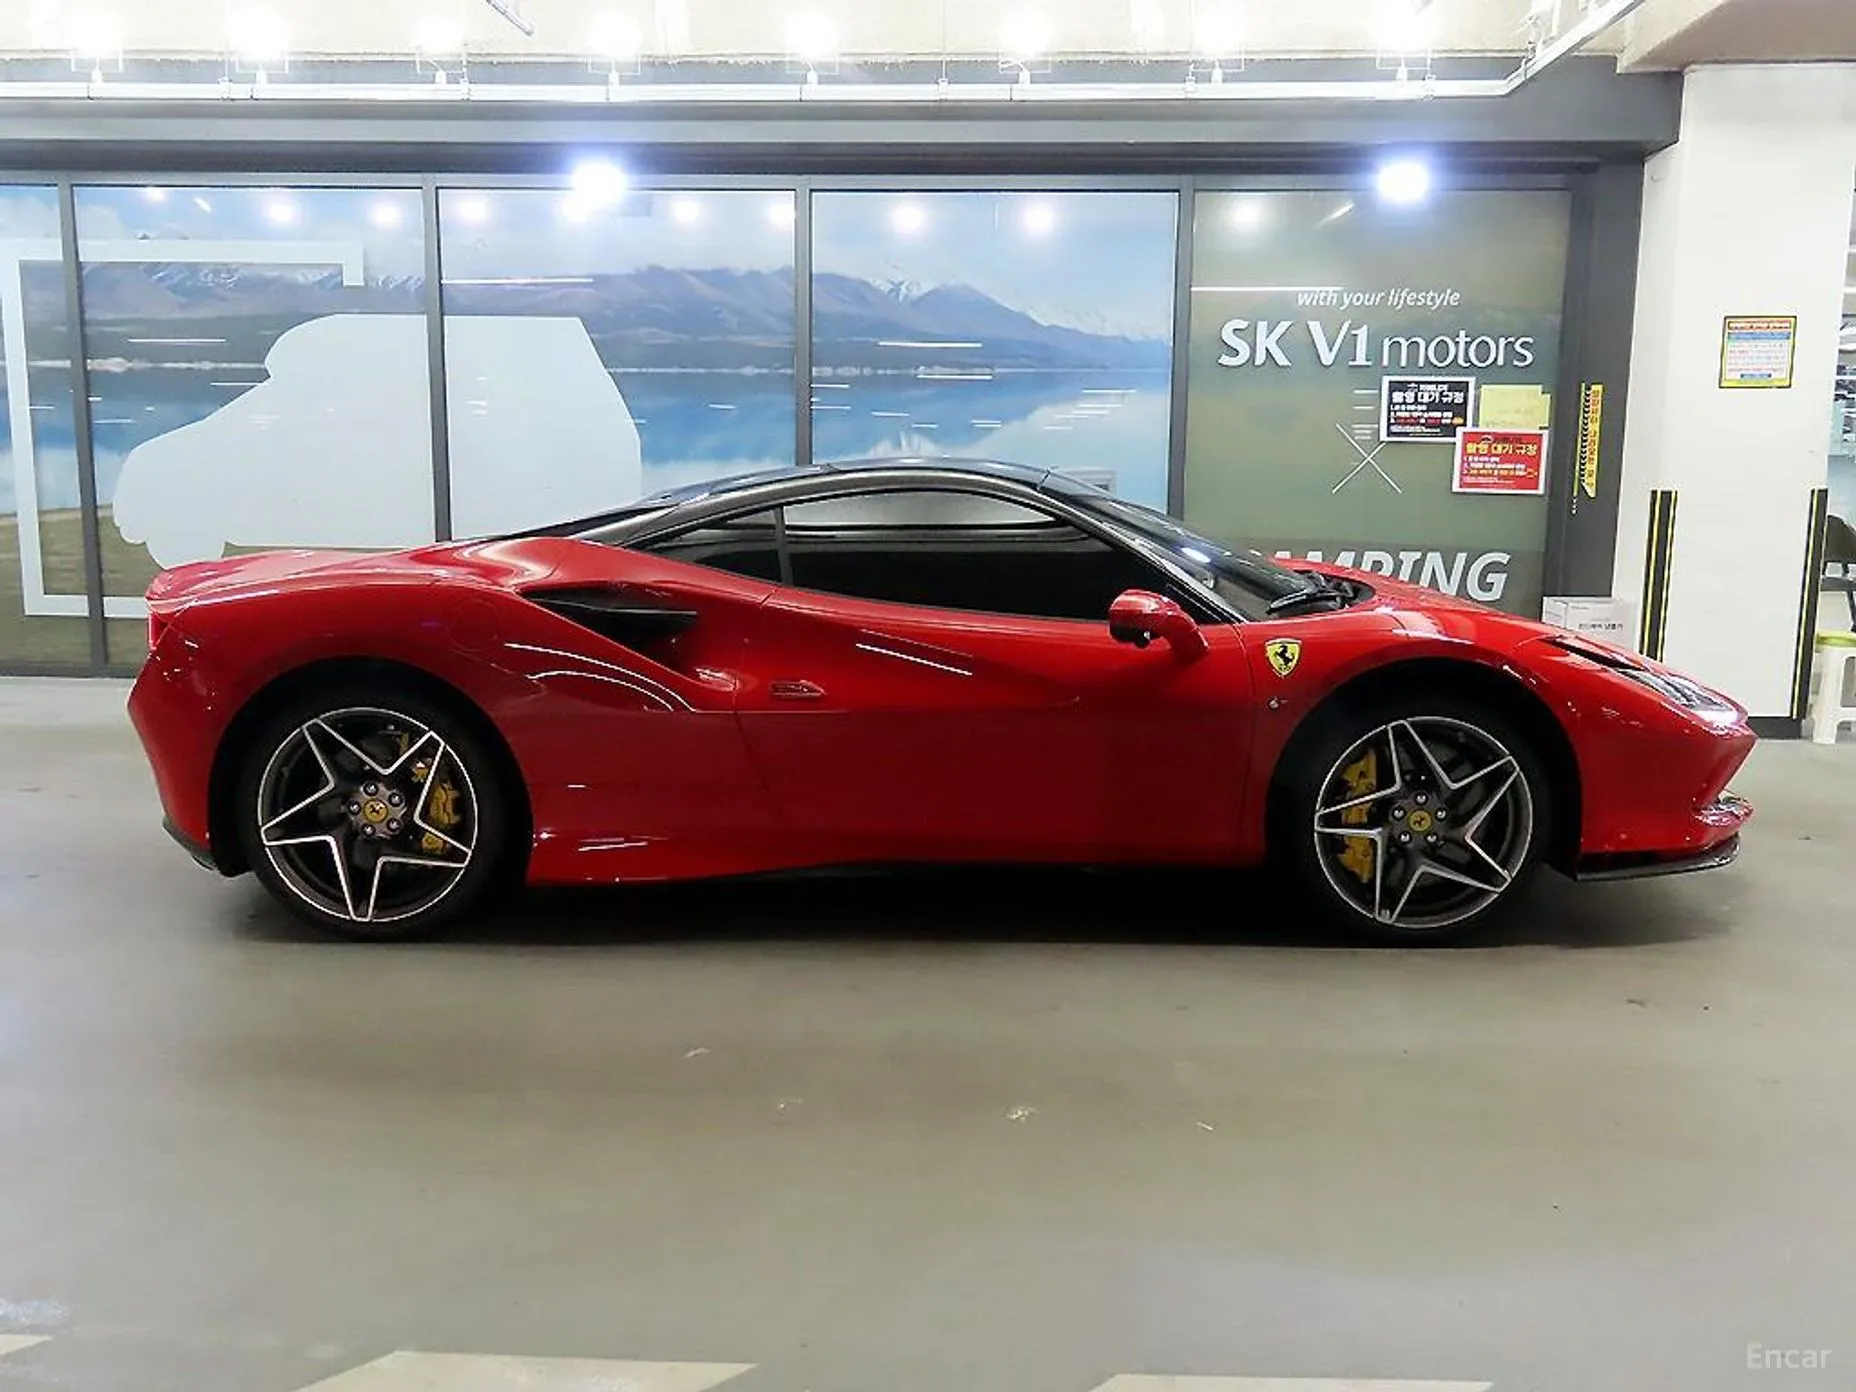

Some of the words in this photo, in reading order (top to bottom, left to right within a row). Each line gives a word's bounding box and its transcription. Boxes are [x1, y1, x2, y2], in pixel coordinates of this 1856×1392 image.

[1297, 289, 1337, 306] with
[1339, 291, 1385, 311] your
[1387, 288, 1461, 310] lifestyle
[1217, 318, 1293, 367] SK
[1306, 319, 1374, 367] V1
[1381, 329, 1535, 368] motors
[1274, 550, 1511, 602] PING
